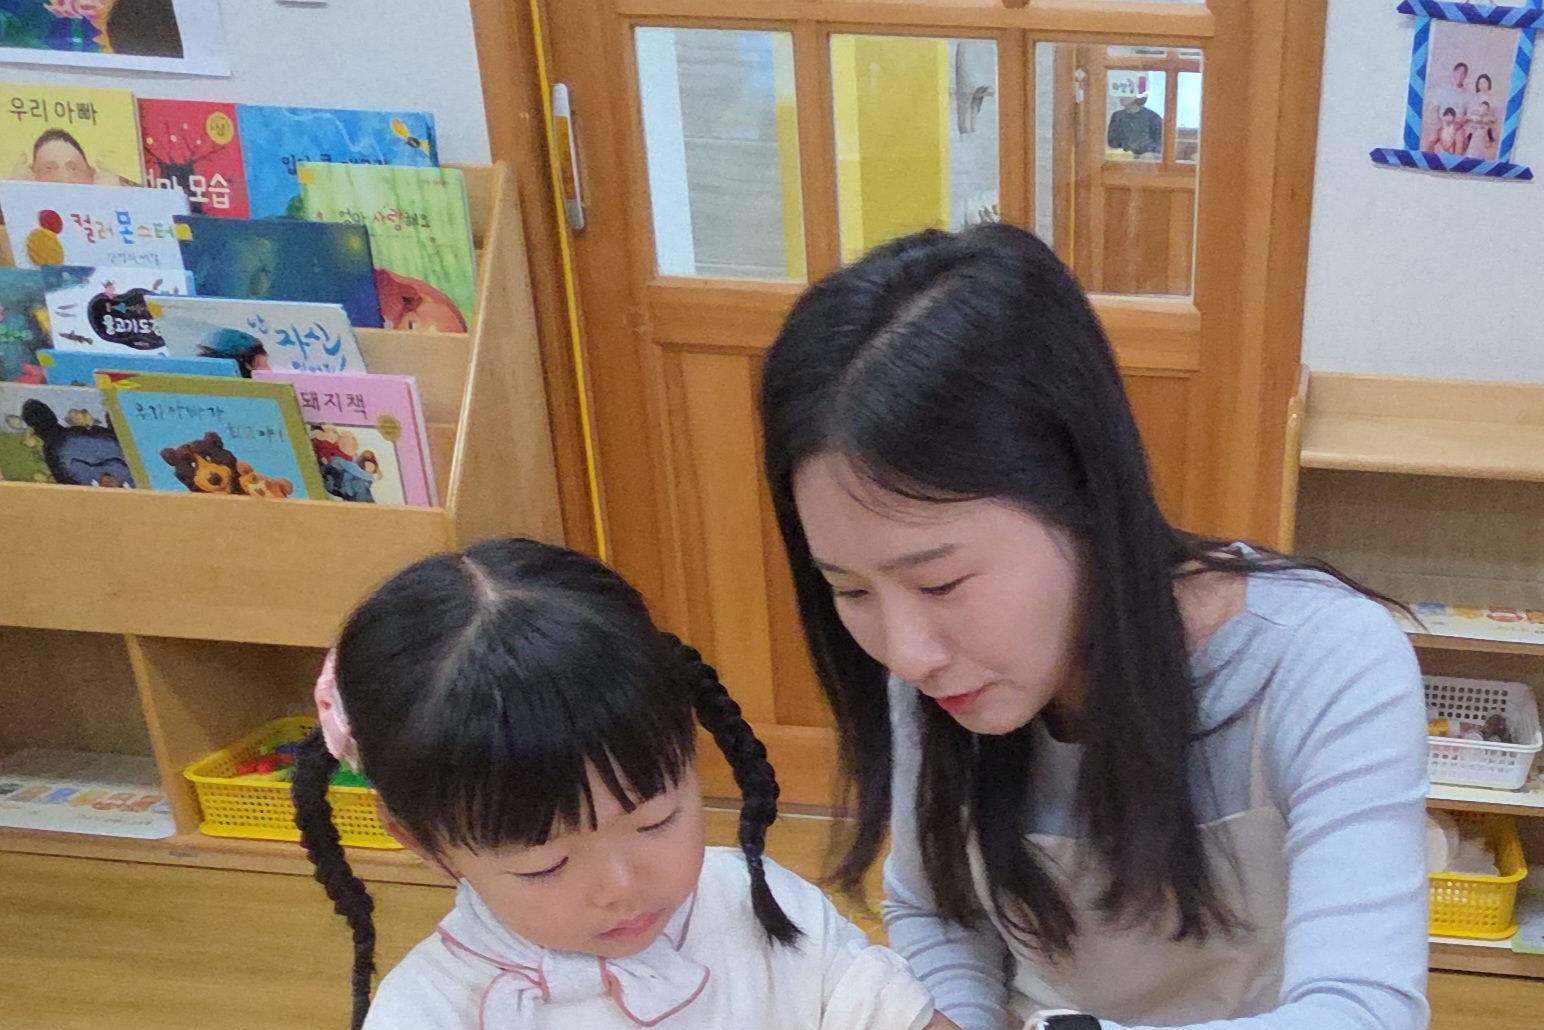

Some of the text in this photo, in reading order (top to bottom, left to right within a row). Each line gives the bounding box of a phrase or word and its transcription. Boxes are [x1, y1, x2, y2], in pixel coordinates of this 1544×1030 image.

[8, 97, 98, 126] 우리 아빠
[189, 172, 232, 209] 모습
[70, 213, 114, 244] 컬러
[300, 386, 368, 420] 돼지책
